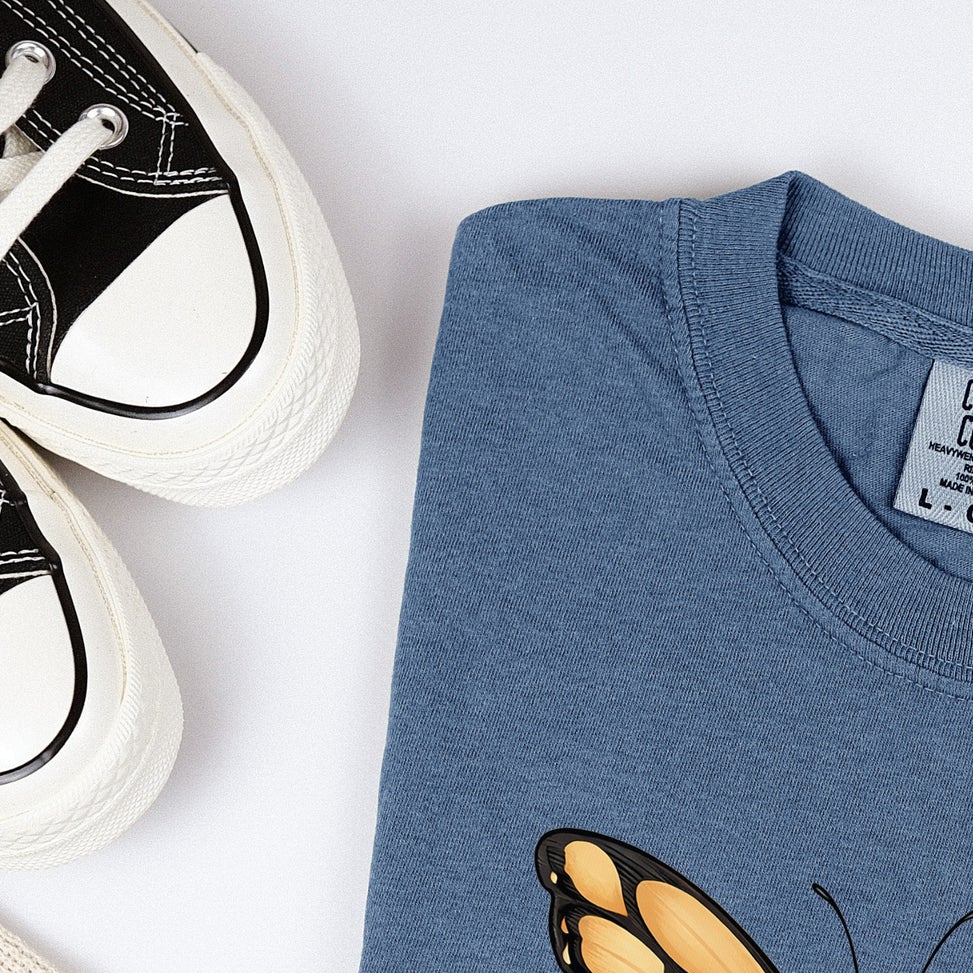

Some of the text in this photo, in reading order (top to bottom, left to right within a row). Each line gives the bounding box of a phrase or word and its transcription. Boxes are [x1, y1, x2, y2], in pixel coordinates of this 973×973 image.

[939, 478, 965, 493] MADE
[965, 486, 973, 496] IN
[918, 488, 933, 510] L
